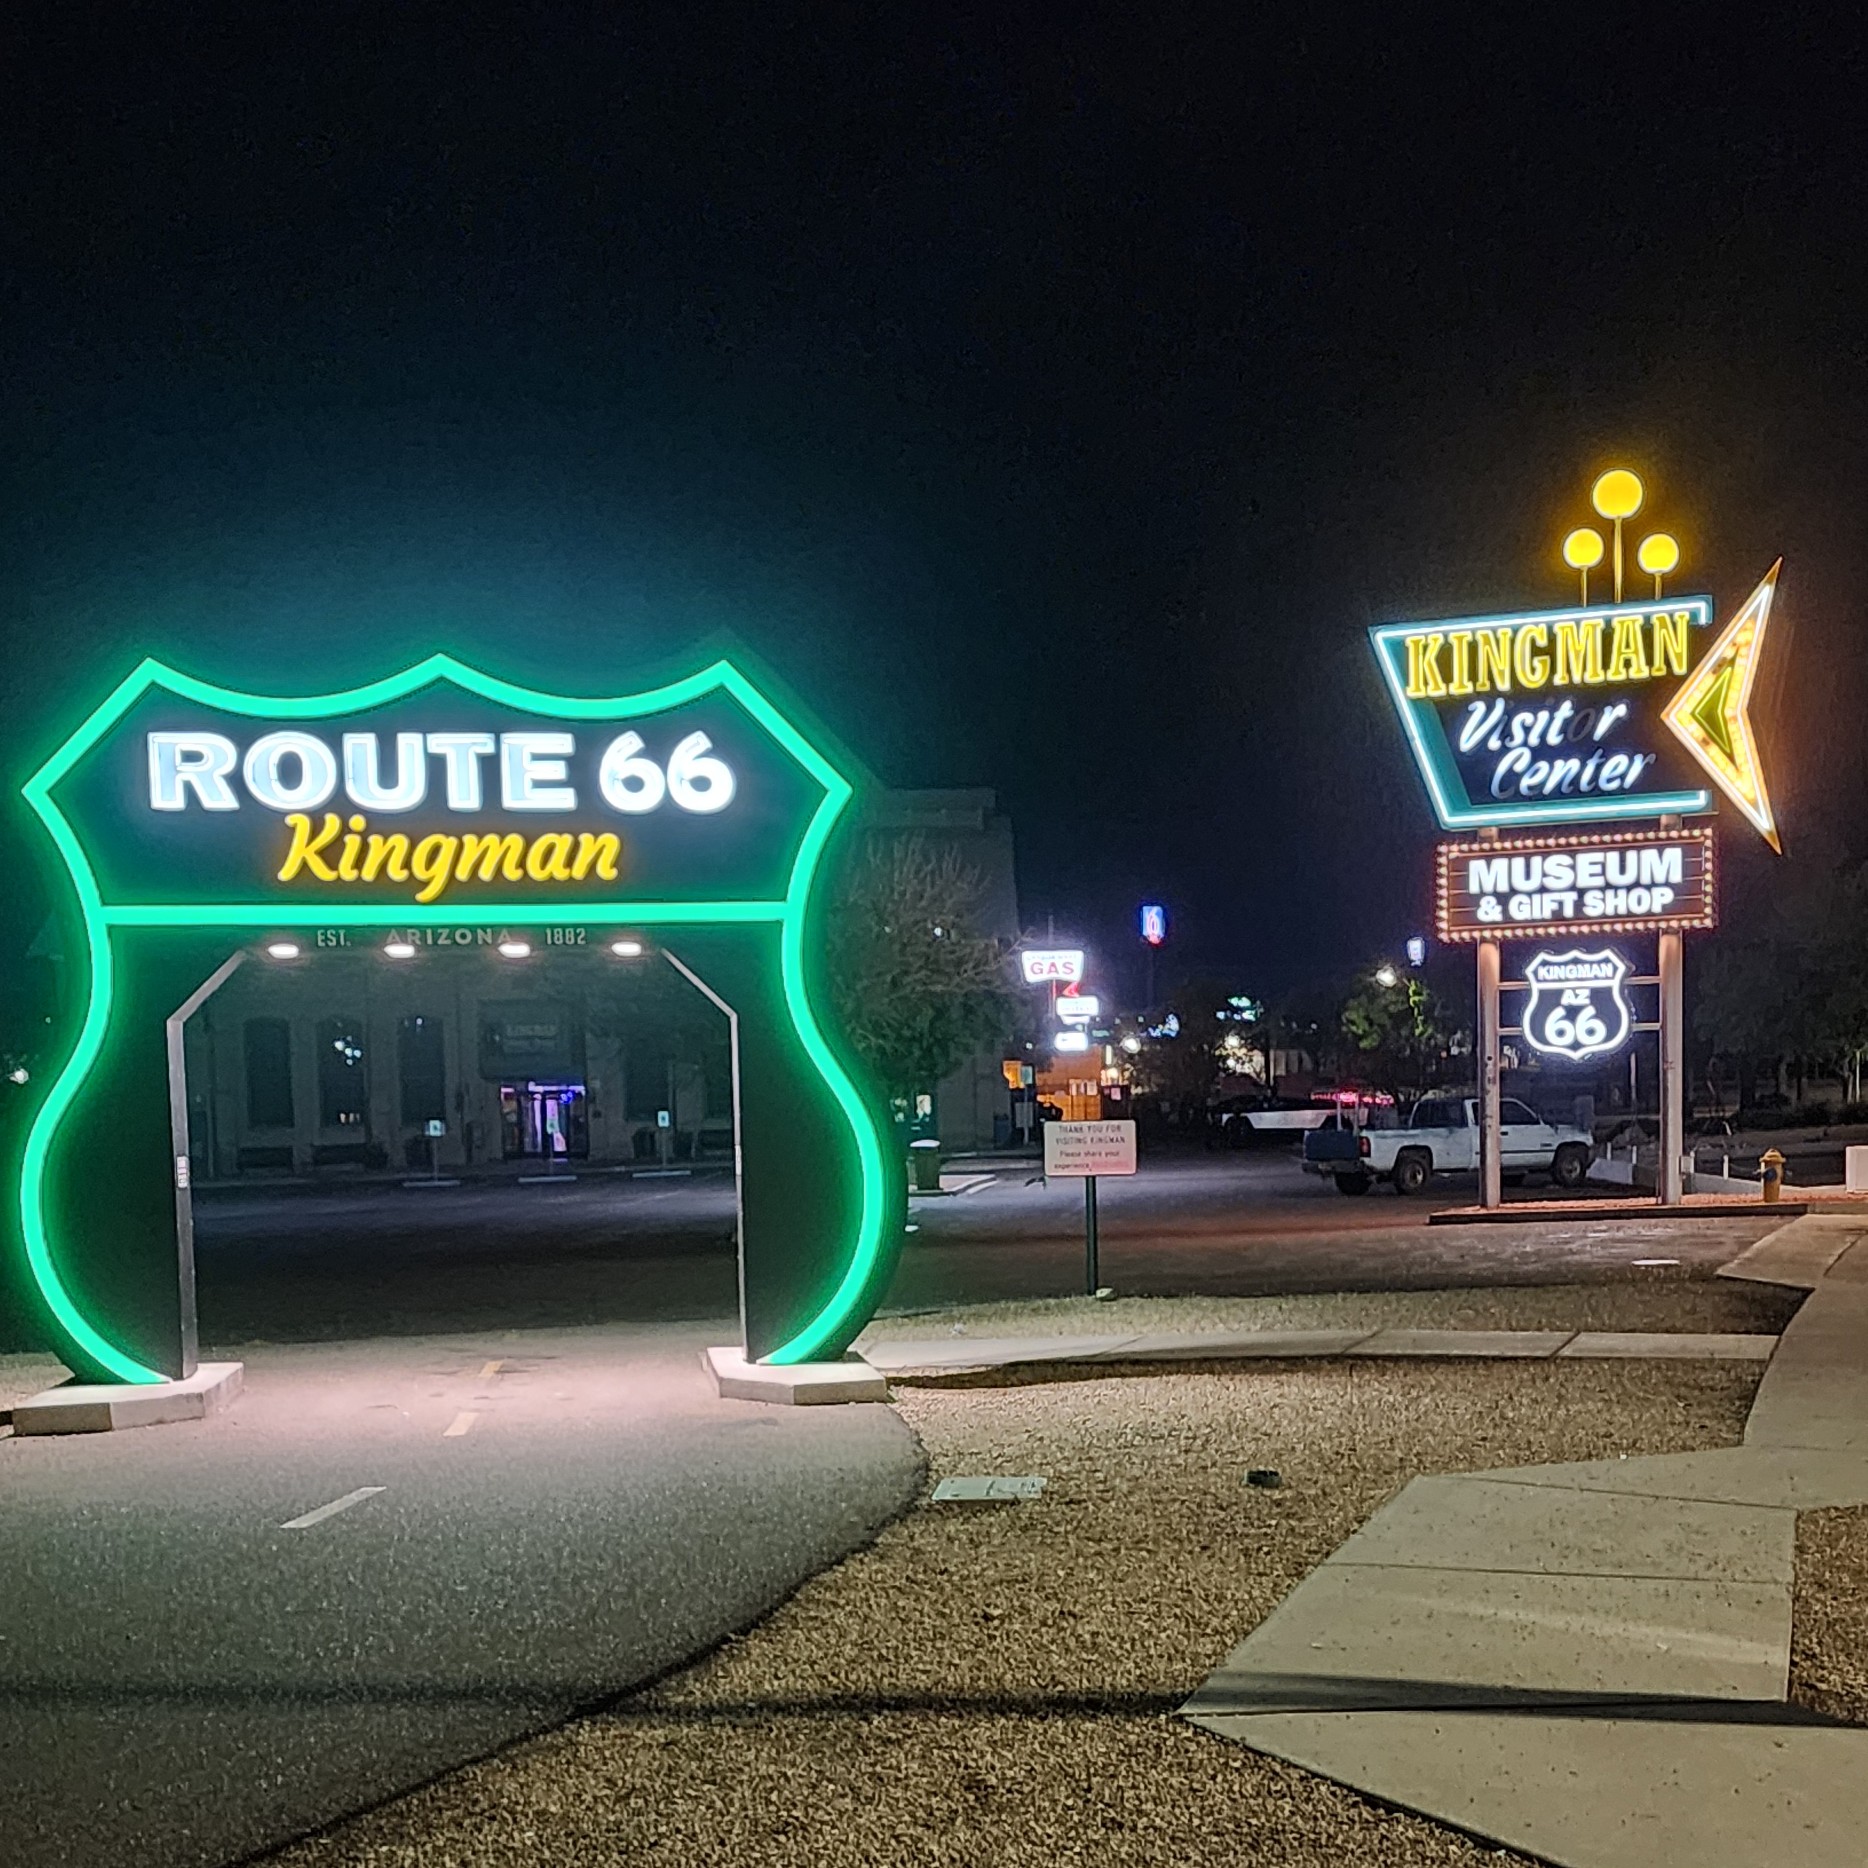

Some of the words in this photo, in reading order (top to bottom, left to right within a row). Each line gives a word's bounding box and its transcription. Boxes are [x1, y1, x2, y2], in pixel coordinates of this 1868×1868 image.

[1406, 612, 1689, 697] KINGMAN
[1459, 698, 1628, 752] Visitor
[147, 731, 578, 813] ROUTE
[599, 730, 736, 814] 66
[1491, 747, 1654, 798] Center
[277, 813, 619, 903] Kingman
[1468, 847, 1683, 894] MUSEUM
[1476, 895, 1503, 922] &
[1508, 890, 1578, 920] GIFT
[1582, 886, 1675, 917] SHOP
[316, 929, 351, 947] EST.
[386, 927, 514, 945] ARIZONA
[545, 927, 588, 945] 1882
[1029, 961, 1075, 976] GAS
[1537, 963, 1614, 980] KINGMAN
[1560, 988, 1591, 1006] AZ
[1544, 1005, 1607, 1046] 66
[1056, 1137, 1087, 1145] VISITING
[1059, 1125, 1083, 1133] THANK
[1087, 1125, 1102, 1133] YOU
[1106, 1124, 1121, 1132] FOR
[1060, 1150, 1081, 1158] Please
[1084, 1150, 1102, 1158] share
